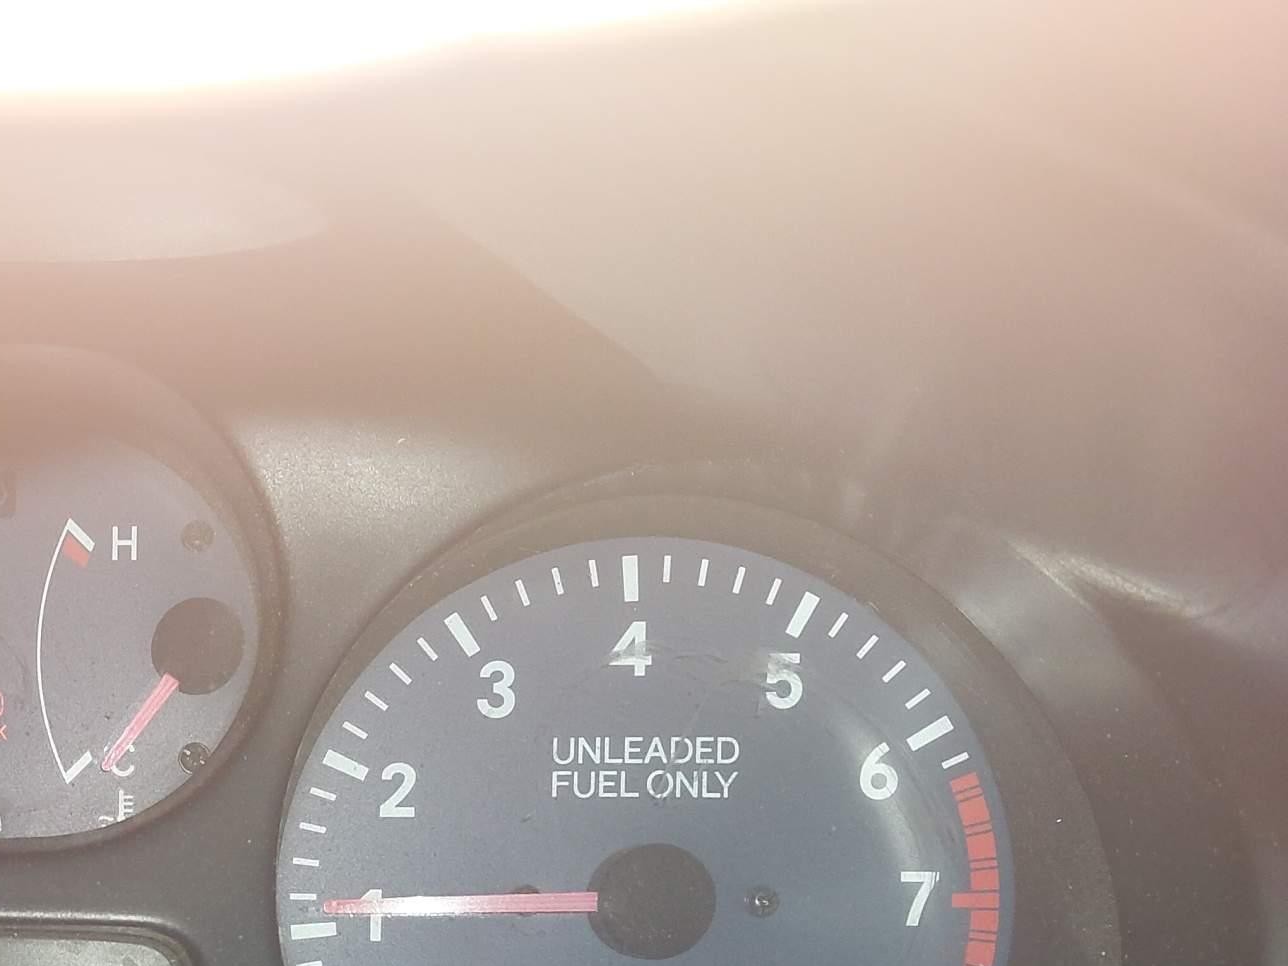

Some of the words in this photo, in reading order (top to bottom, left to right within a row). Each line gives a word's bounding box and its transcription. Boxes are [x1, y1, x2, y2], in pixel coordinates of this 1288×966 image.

[112, 526, 137, 560] H
[610, 622, 652, 676] 4
[477, 661, 515, 718] 3
[766, 653, 802, 709] 5
[553, 737, 739, 764] UNLEADED
[860, 743, 898, 800] 6
[380, 763, 416, 817] 2
[552, 771, 639, 798] FUEL
[647, 770, 738, 798] ONLY
[358, 888, 382, 941] 1
[901, 871, 939, 926] 7
